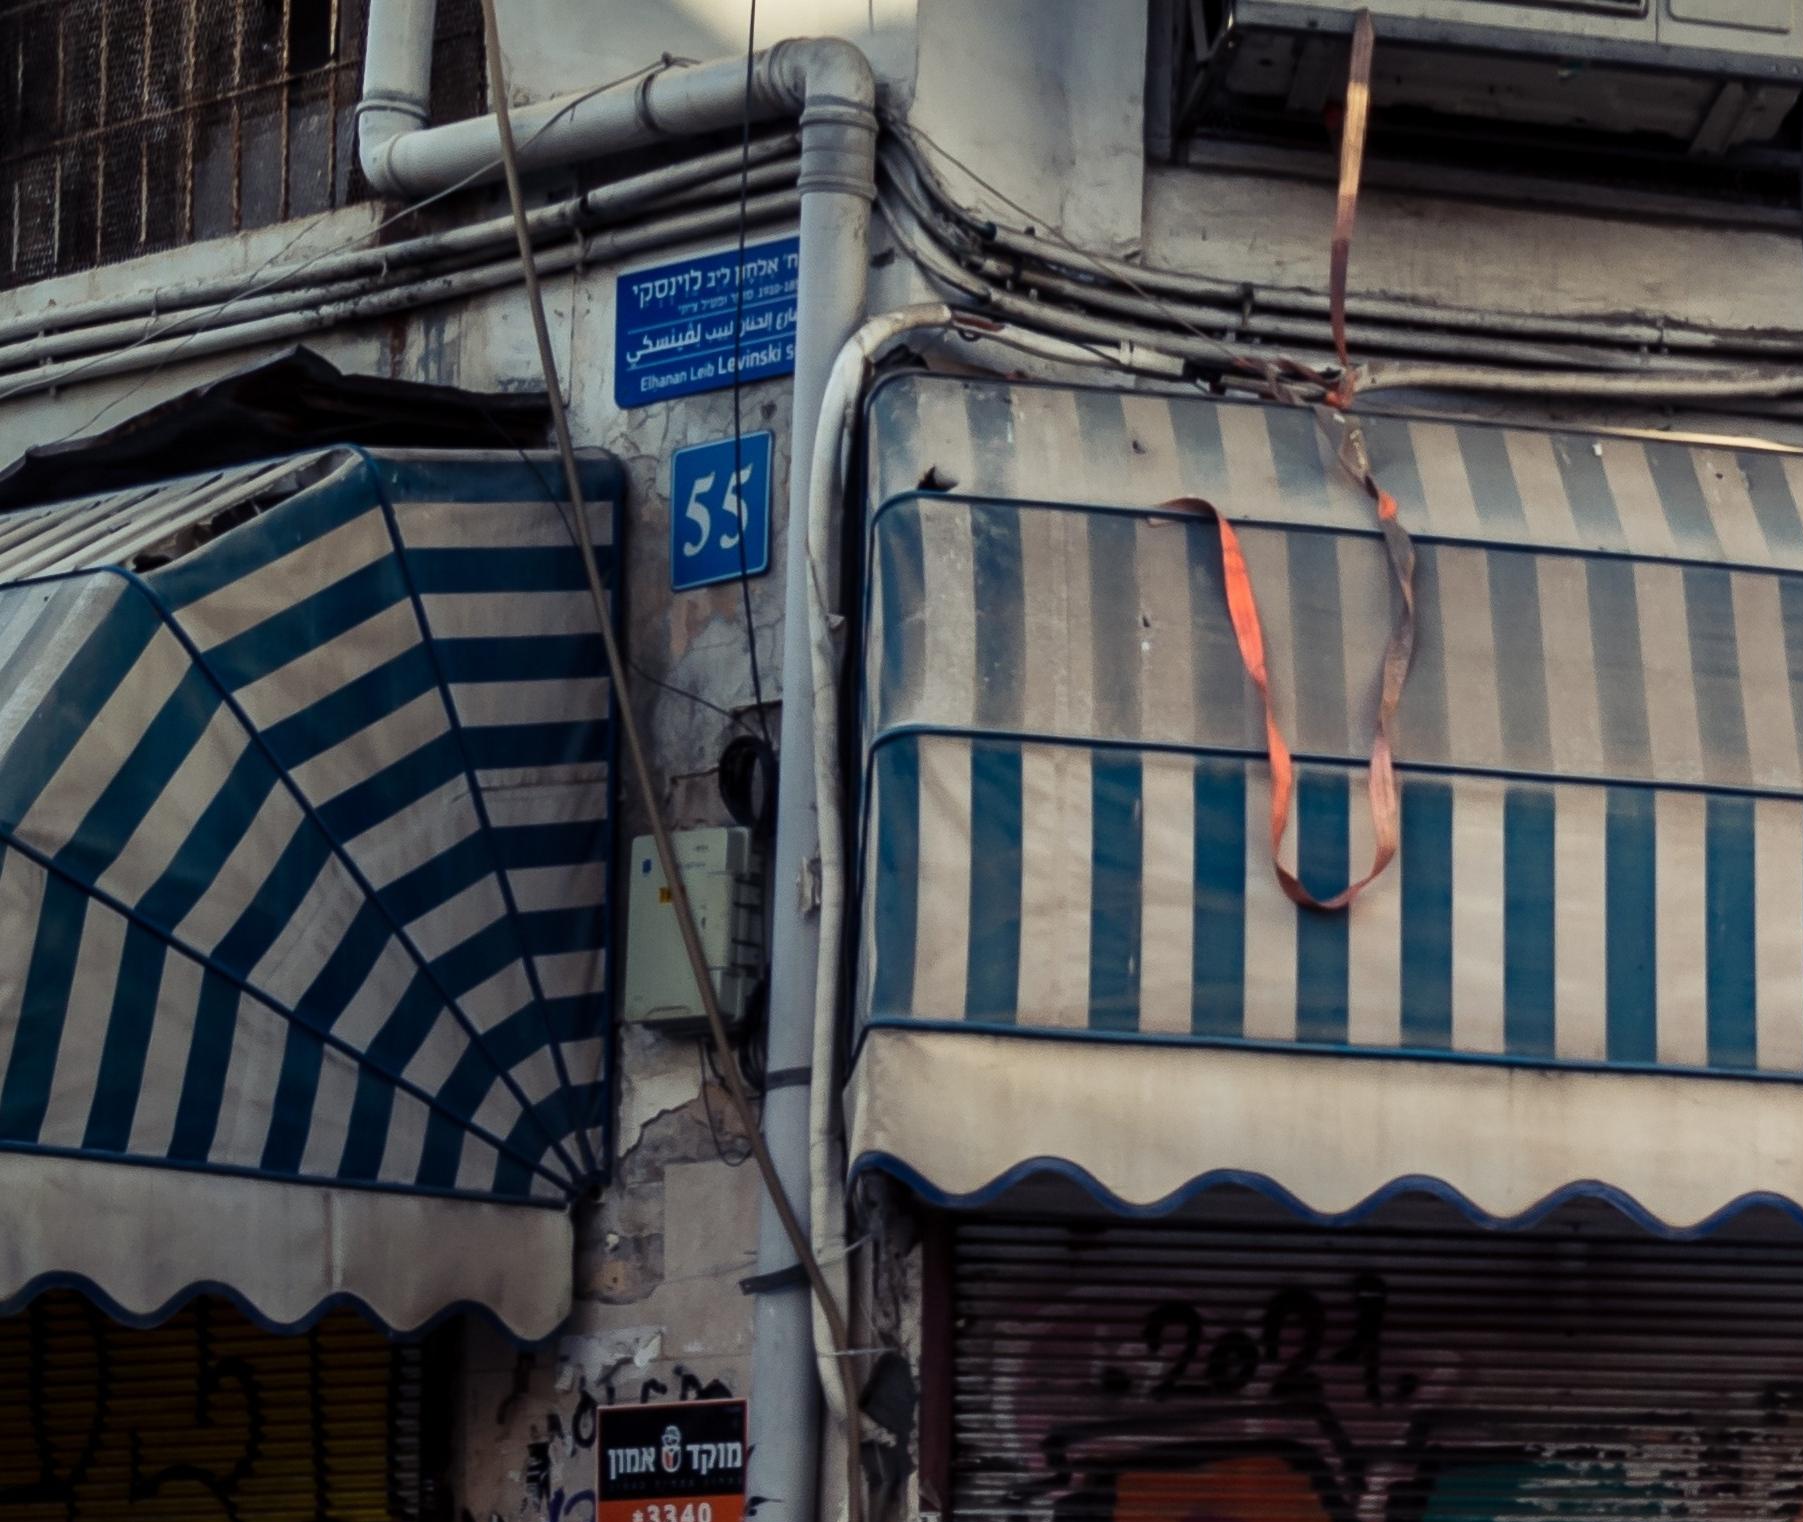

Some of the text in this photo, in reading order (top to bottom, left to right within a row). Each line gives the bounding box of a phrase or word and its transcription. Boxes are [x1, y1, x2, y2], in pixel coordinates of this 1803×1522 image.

[690, 362, 715, 381] Leib
[718, 342, 782, 375] Levinski
[683, 463, 753, 557] 55
[607, 1441, 742, 1480] מוקד אמון
